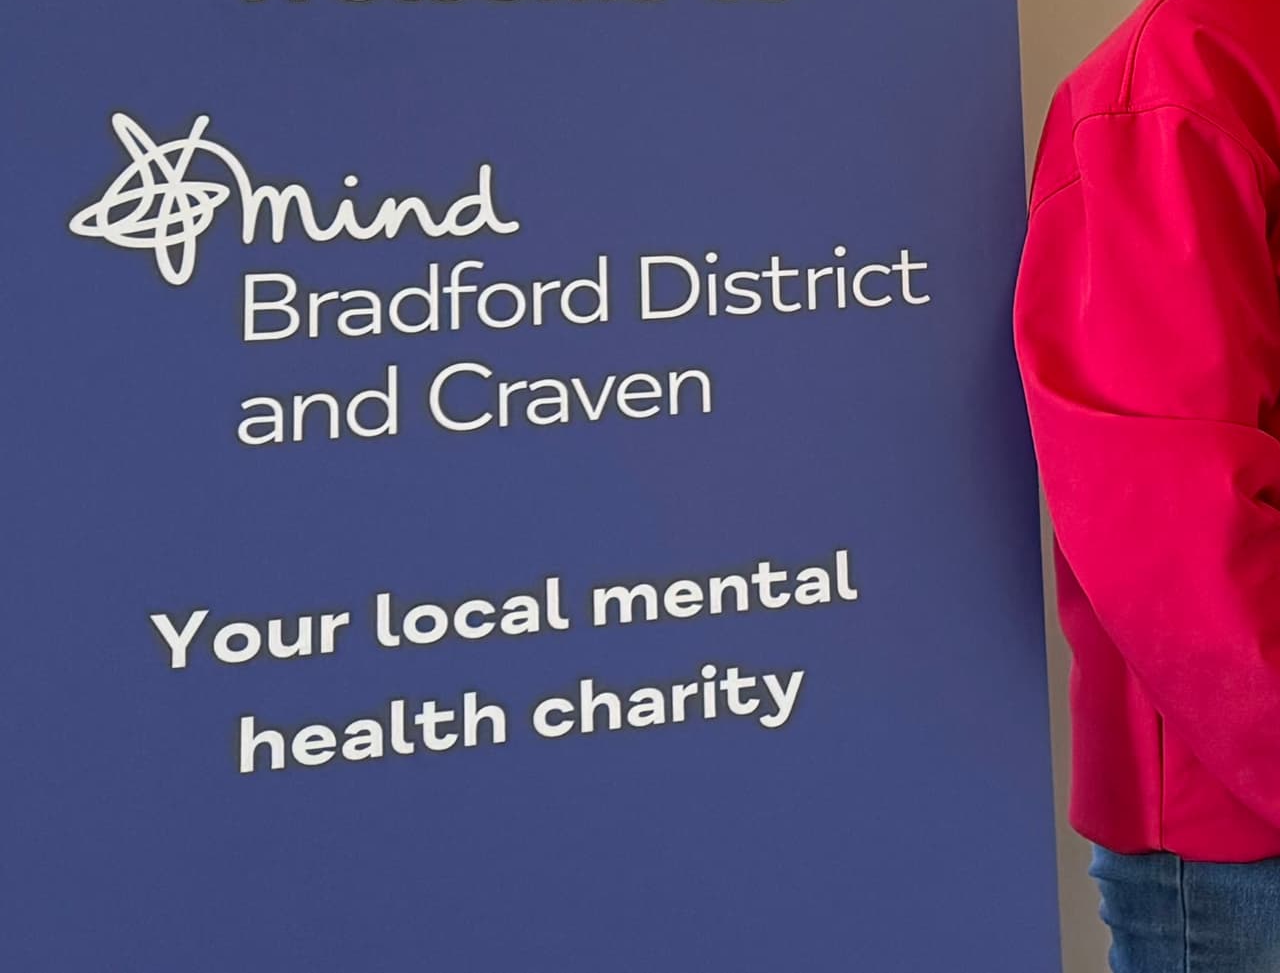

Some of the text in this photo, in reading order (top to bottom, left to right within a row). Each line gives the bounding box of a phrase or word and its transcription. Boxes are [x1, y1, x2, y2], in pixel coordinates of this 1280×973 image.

[241, 165, 519, 244] mind
[245, 246, 930, 340] Bradford District
[238, 363, 710, 444] and Craven
[151, 551, 857, 668] Your local mental
[241, 665, 804, 772] health charity
